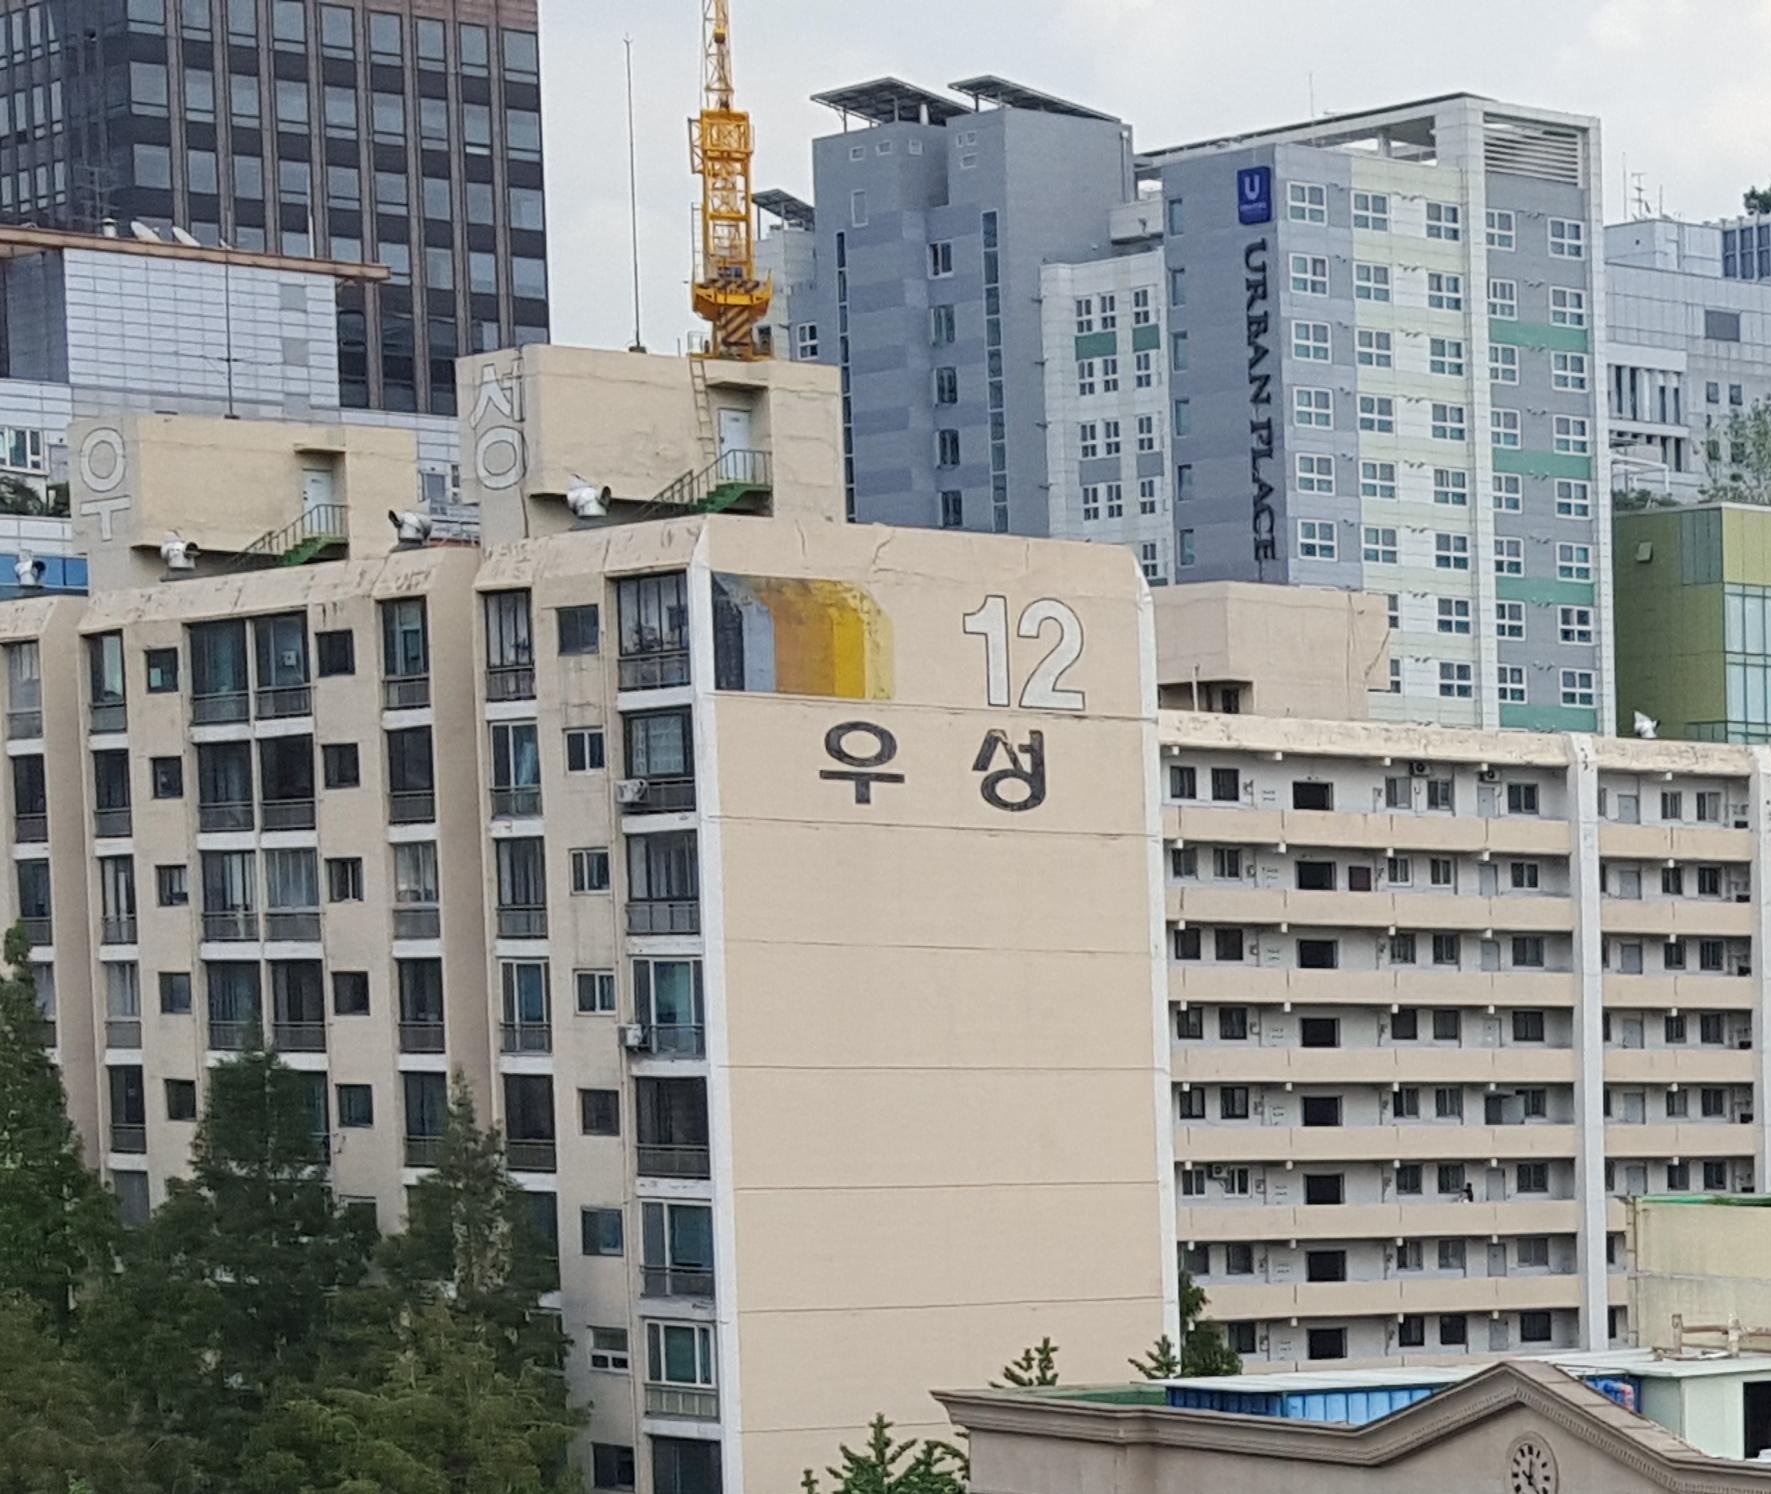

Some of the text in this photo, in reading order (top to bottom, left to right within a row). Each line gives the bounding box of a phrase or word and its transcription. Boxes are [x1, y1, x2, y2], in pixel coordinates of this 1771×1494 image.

[1243, 237, 1270, 405] URBAN
[1248, 416, 1278, 563] PLACE
[962, 593, 1087, 711] 12
